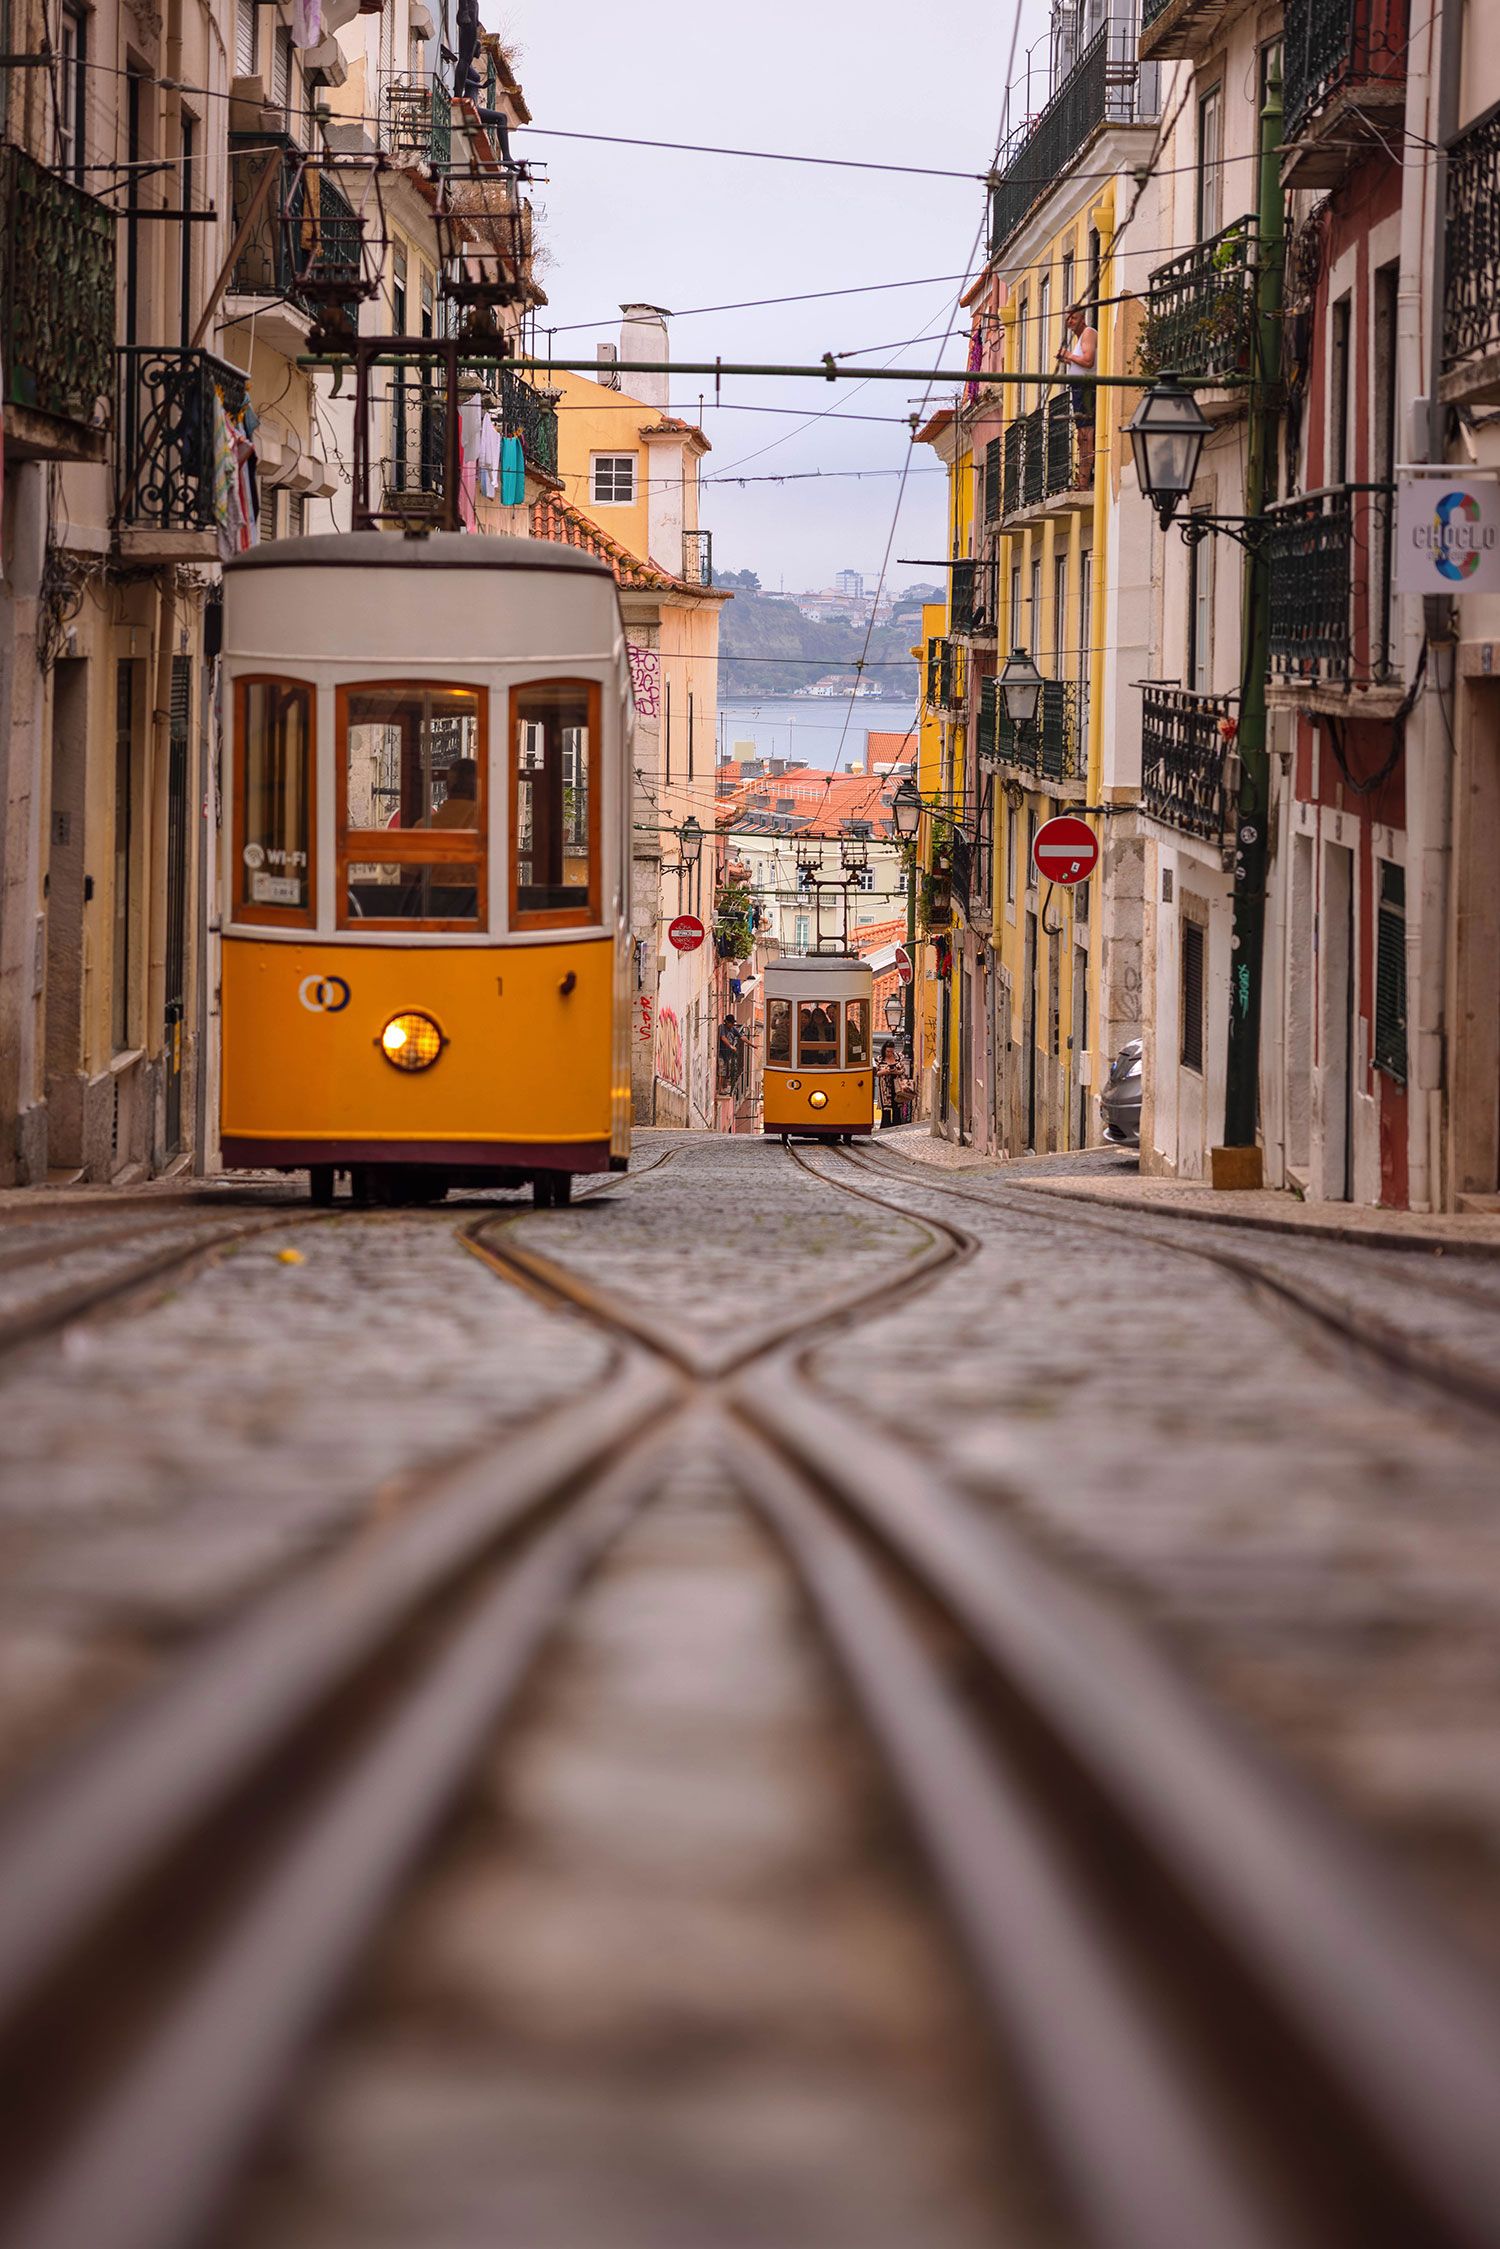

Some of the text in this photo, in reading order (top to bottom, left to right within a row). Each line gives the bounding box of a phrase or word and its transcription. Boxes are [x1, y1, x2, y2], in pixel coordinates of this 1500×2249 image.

[1412, 525, 1496, 550] CHOCLO
[267, 849, 306, 867] WI-FI
[496, 976, 503, 997] 1
[840, 1080, 846, 1088] 2
